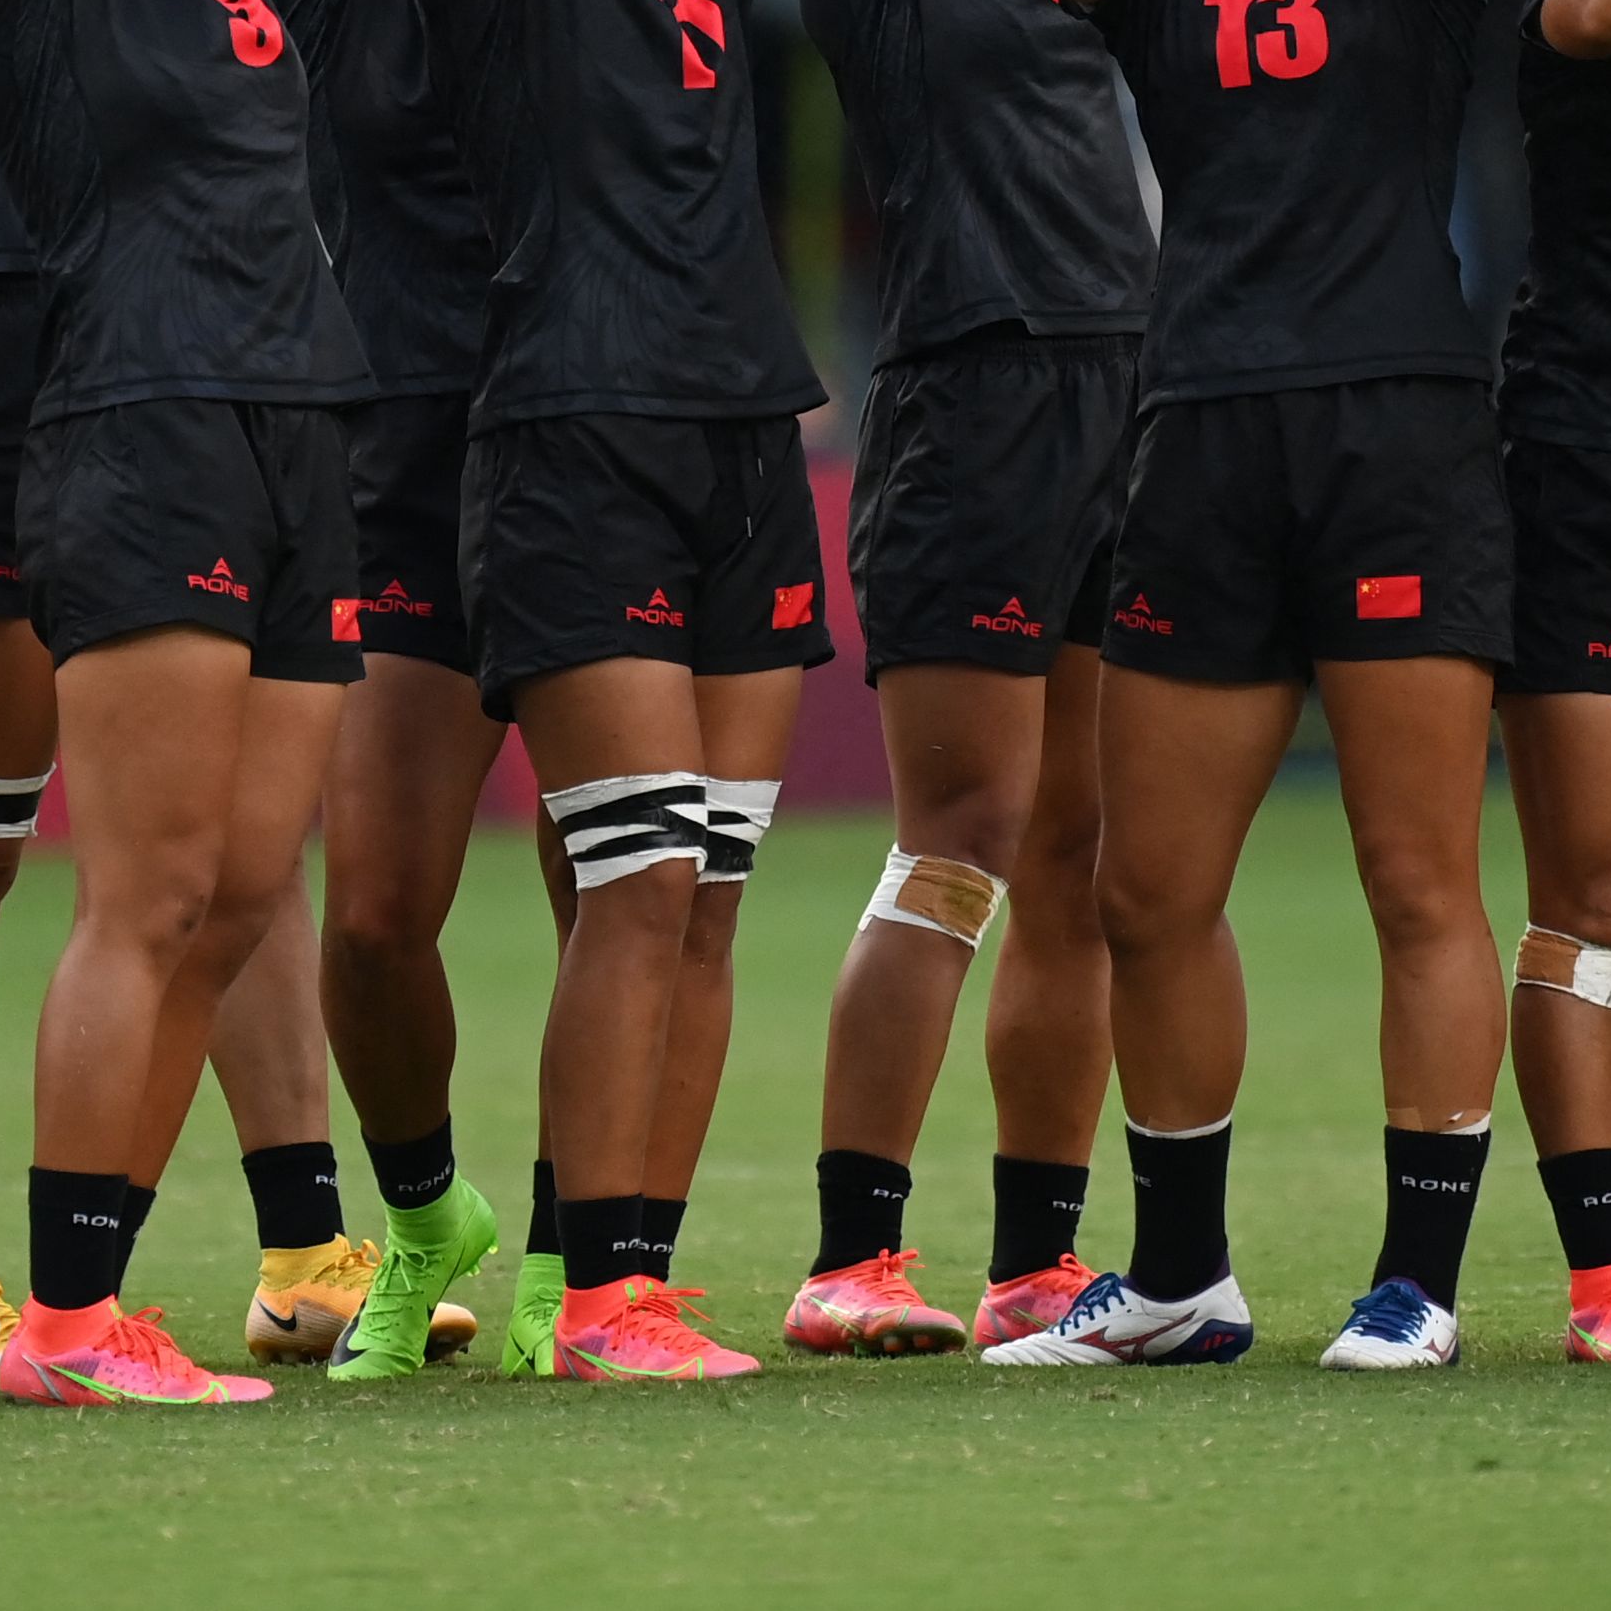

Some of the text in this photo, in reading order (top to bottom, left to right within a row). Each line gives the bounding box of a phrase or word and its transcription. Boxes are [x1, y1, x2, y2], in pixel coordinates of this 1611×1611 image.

[187, 574, 251, 603] AONE
[625, 605, 686, 629] AONE
[972, 613, 1045, 639] AONE
[1114, 609, 1175, 636] AONE
[1401, 1175, 1473, 1194] AONE
[72, 1212, 120, 1230] AON
